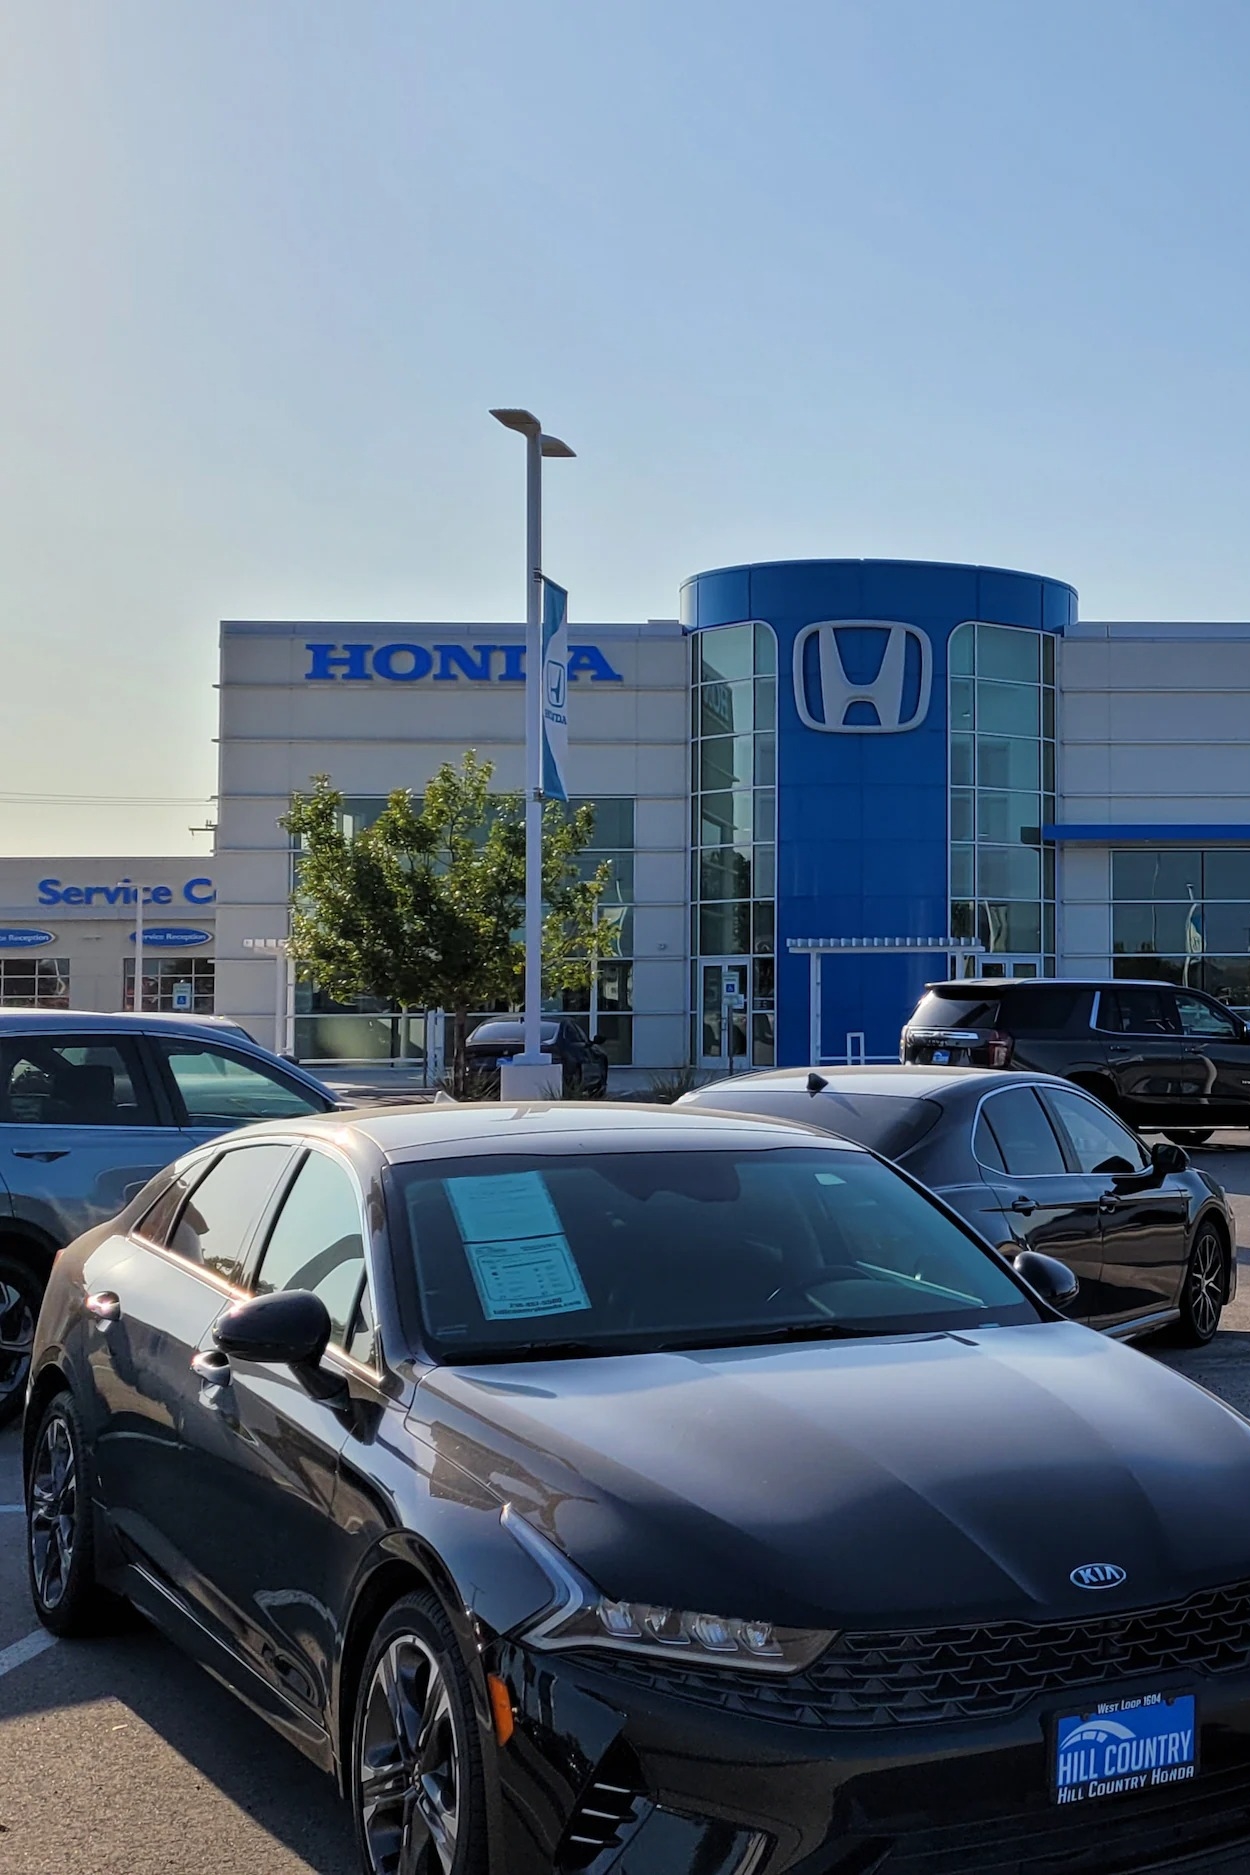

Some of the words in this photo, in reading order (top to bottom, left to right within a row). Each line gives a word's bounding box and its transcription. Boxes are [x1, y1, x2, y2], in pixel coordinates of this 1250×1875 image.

[183, 877, 216, 905] C
[1077, 1565, 1121, 1584] KIA
[1143, 1692, 1162, 1706] 1604
[1057, 1748, 1098, 1786] HILL
[1104, 1729, 1193, 1777] COUNTRY
